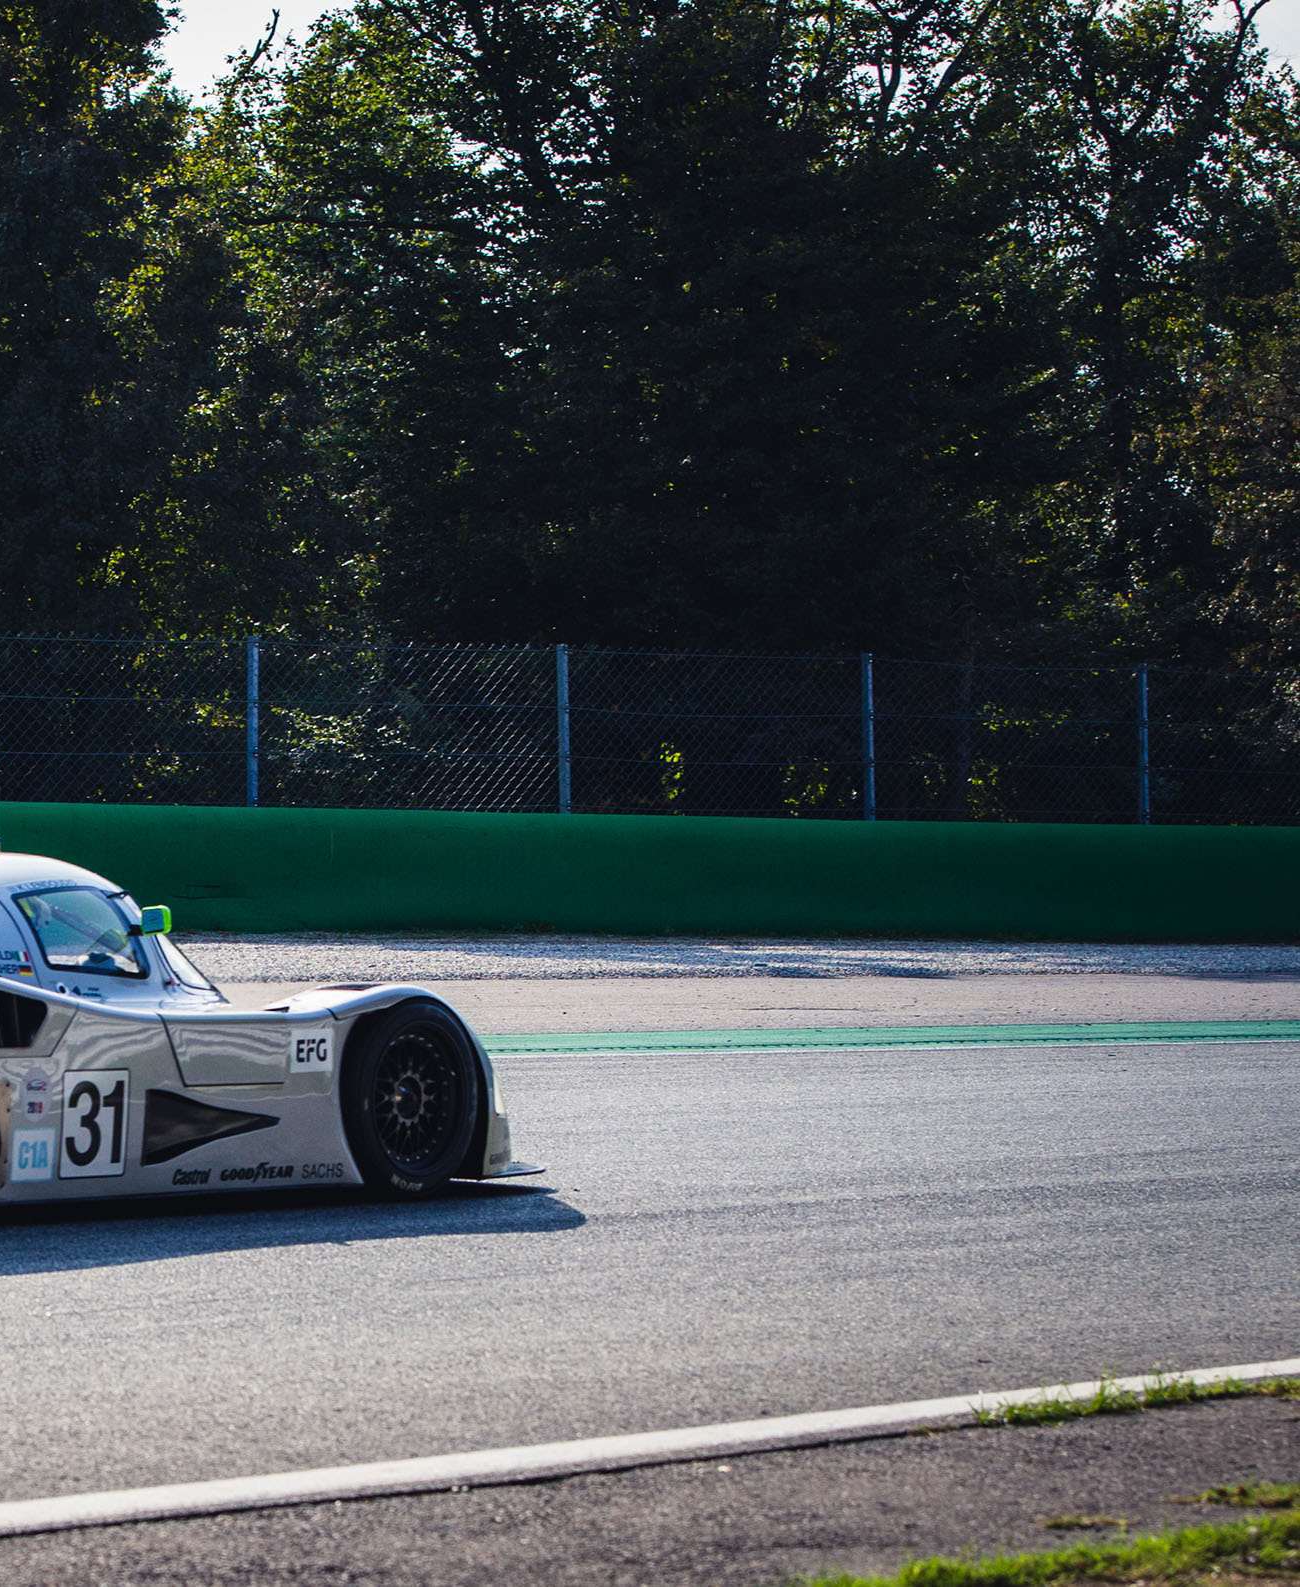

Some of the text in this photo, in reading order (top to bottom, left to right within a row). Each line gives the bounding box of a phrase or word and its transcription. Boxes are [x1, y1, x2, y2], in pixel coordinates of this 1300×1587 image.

[296, 1038, 327, 1063] EFG
[65, 1080, 125, 1167] 31
[18, 1141, 49, 1170] C1A
[172, 1168, 212, 1186] Castrol
[219, 1162, 295, 1184] GOODYEAR
[301, 1162, 344, 1180] SACHS
